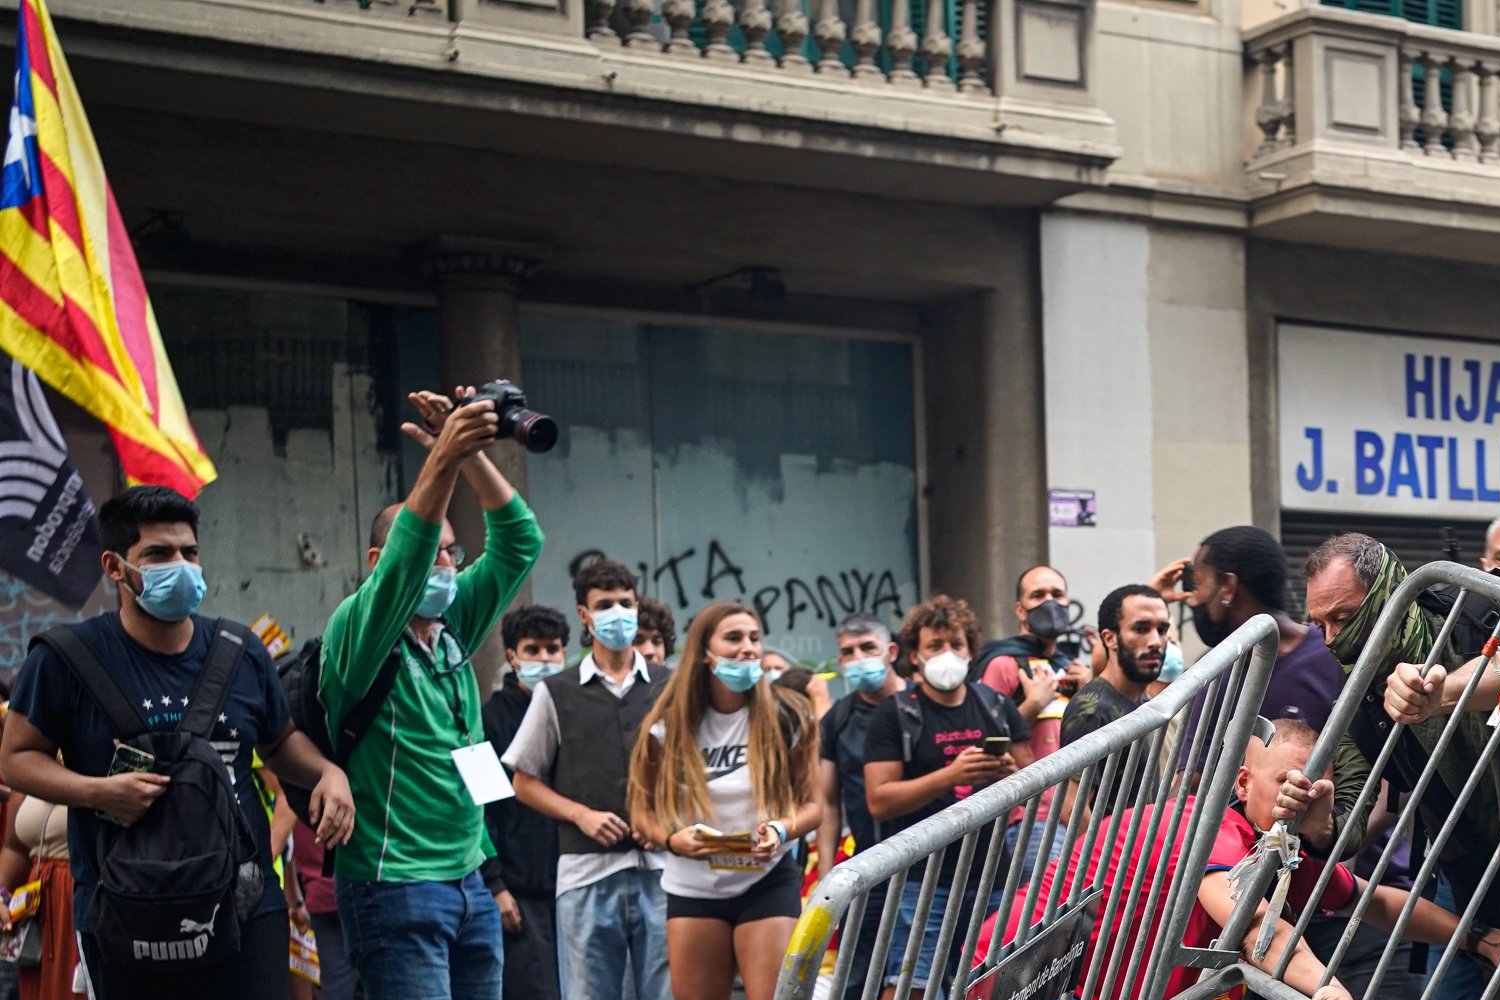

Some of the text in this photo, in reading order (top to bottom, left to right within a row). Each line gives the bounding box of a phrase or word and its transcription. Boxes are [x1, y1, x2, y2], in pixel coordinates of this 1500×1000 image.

[1296, 427, 1338, 494] J.
[702, 744, 748, 768] NIKE
[133, 932, 209, 961] PUMA
[1048, 941, 1085, 981] Barcelona
